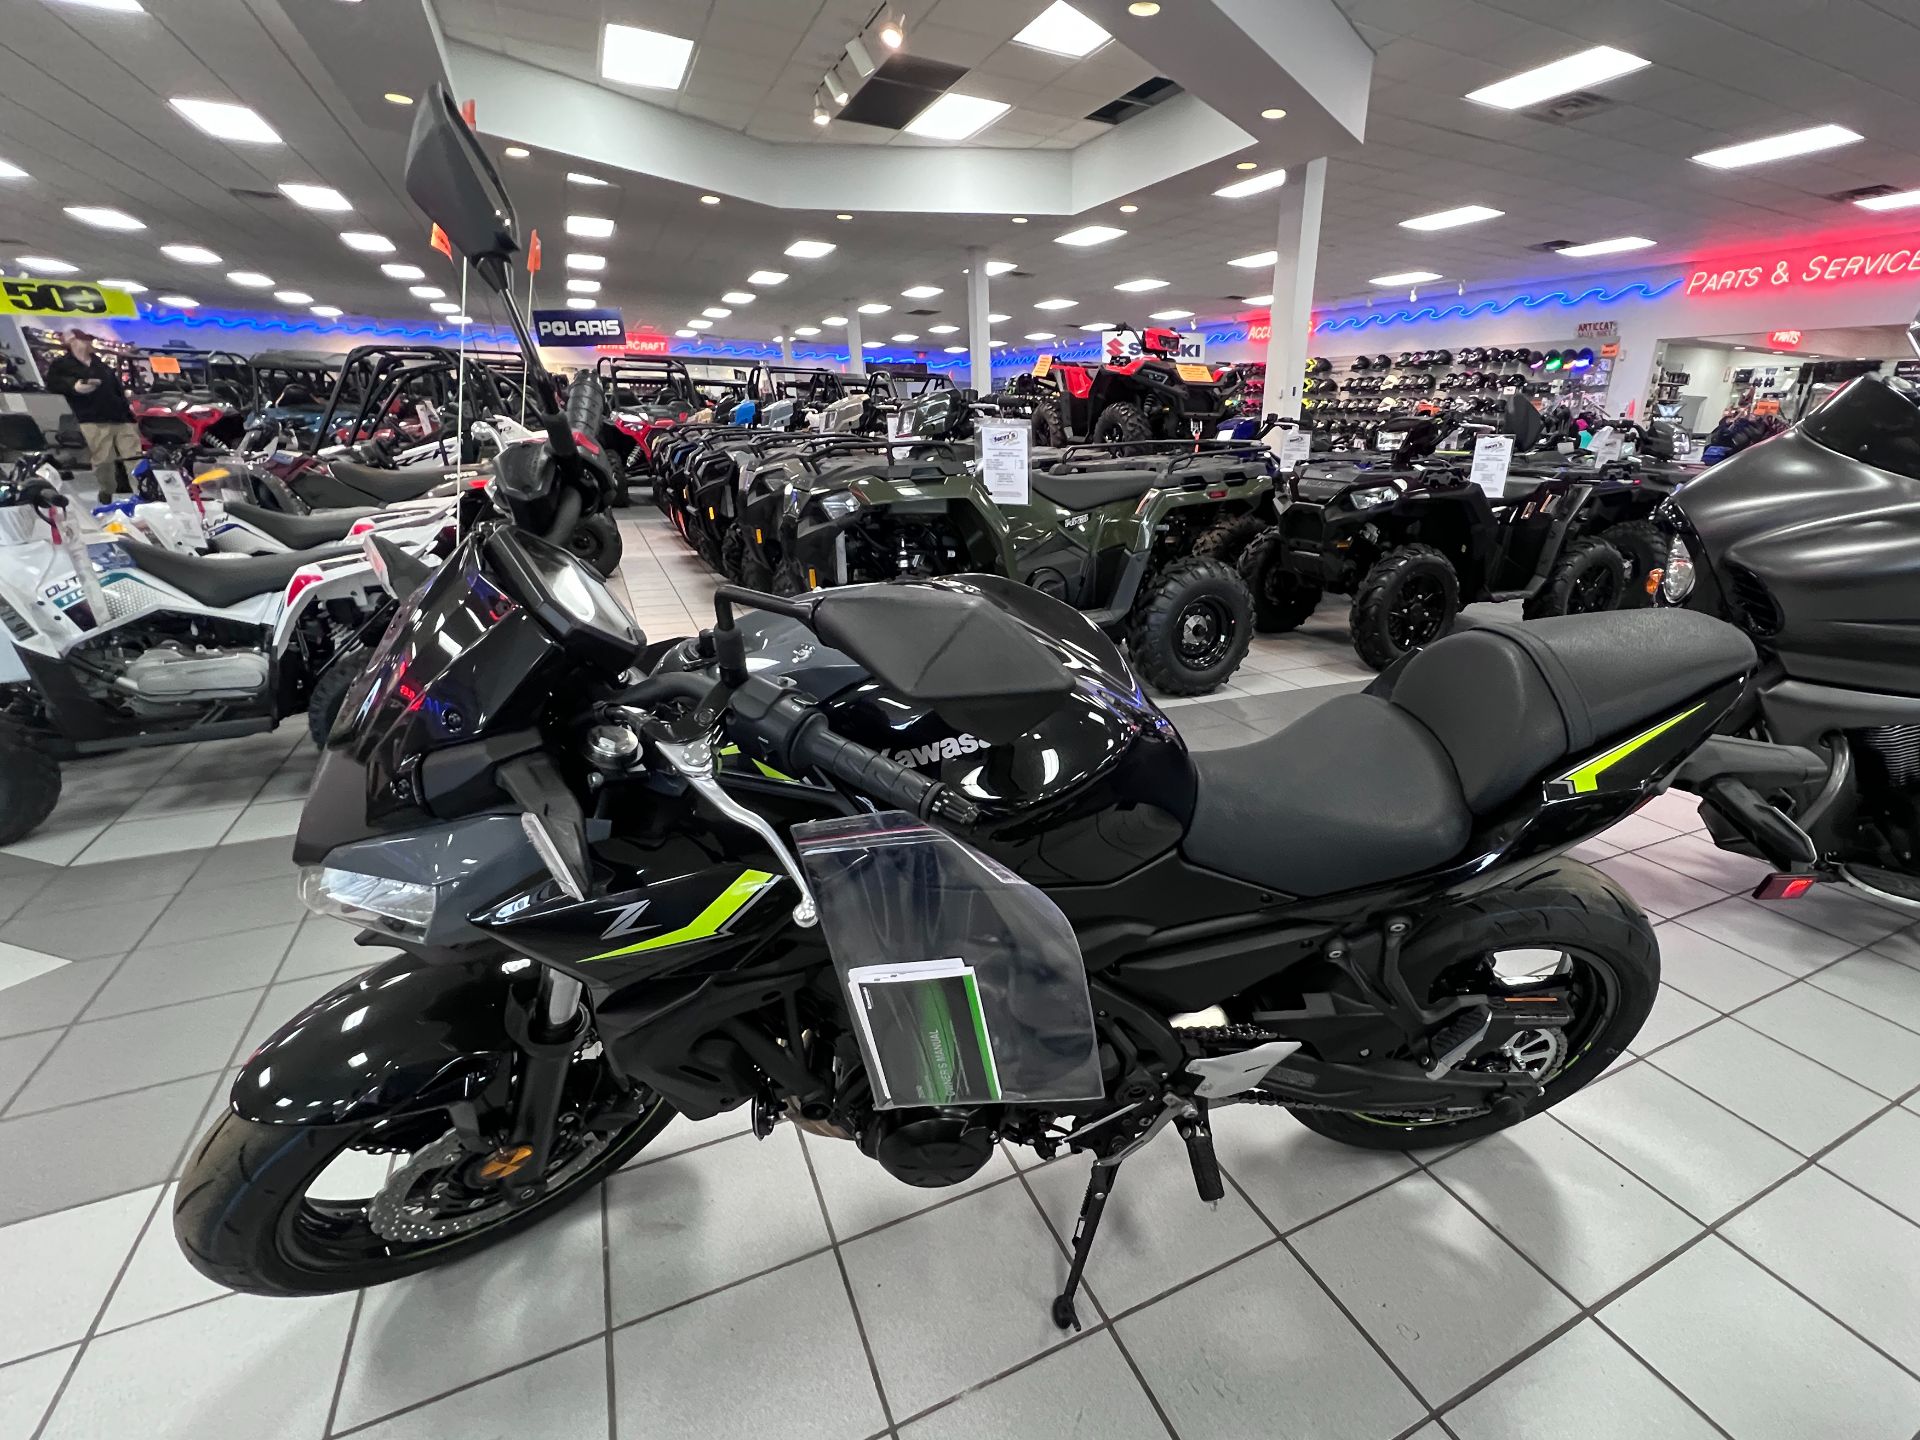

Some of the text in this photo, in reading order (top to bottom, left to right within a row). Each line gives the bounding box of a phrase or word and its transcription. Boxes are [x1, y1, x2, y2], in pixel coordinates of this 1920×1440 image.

[1687, 266, 1763, 295] PARTS
[1770, 260, 1790, 286] &
[538, 319, 621, 336] POLARIS
[1773, 330, 1801, 344] PARTS
[929, 1029, 948, 1062] MANUAL
